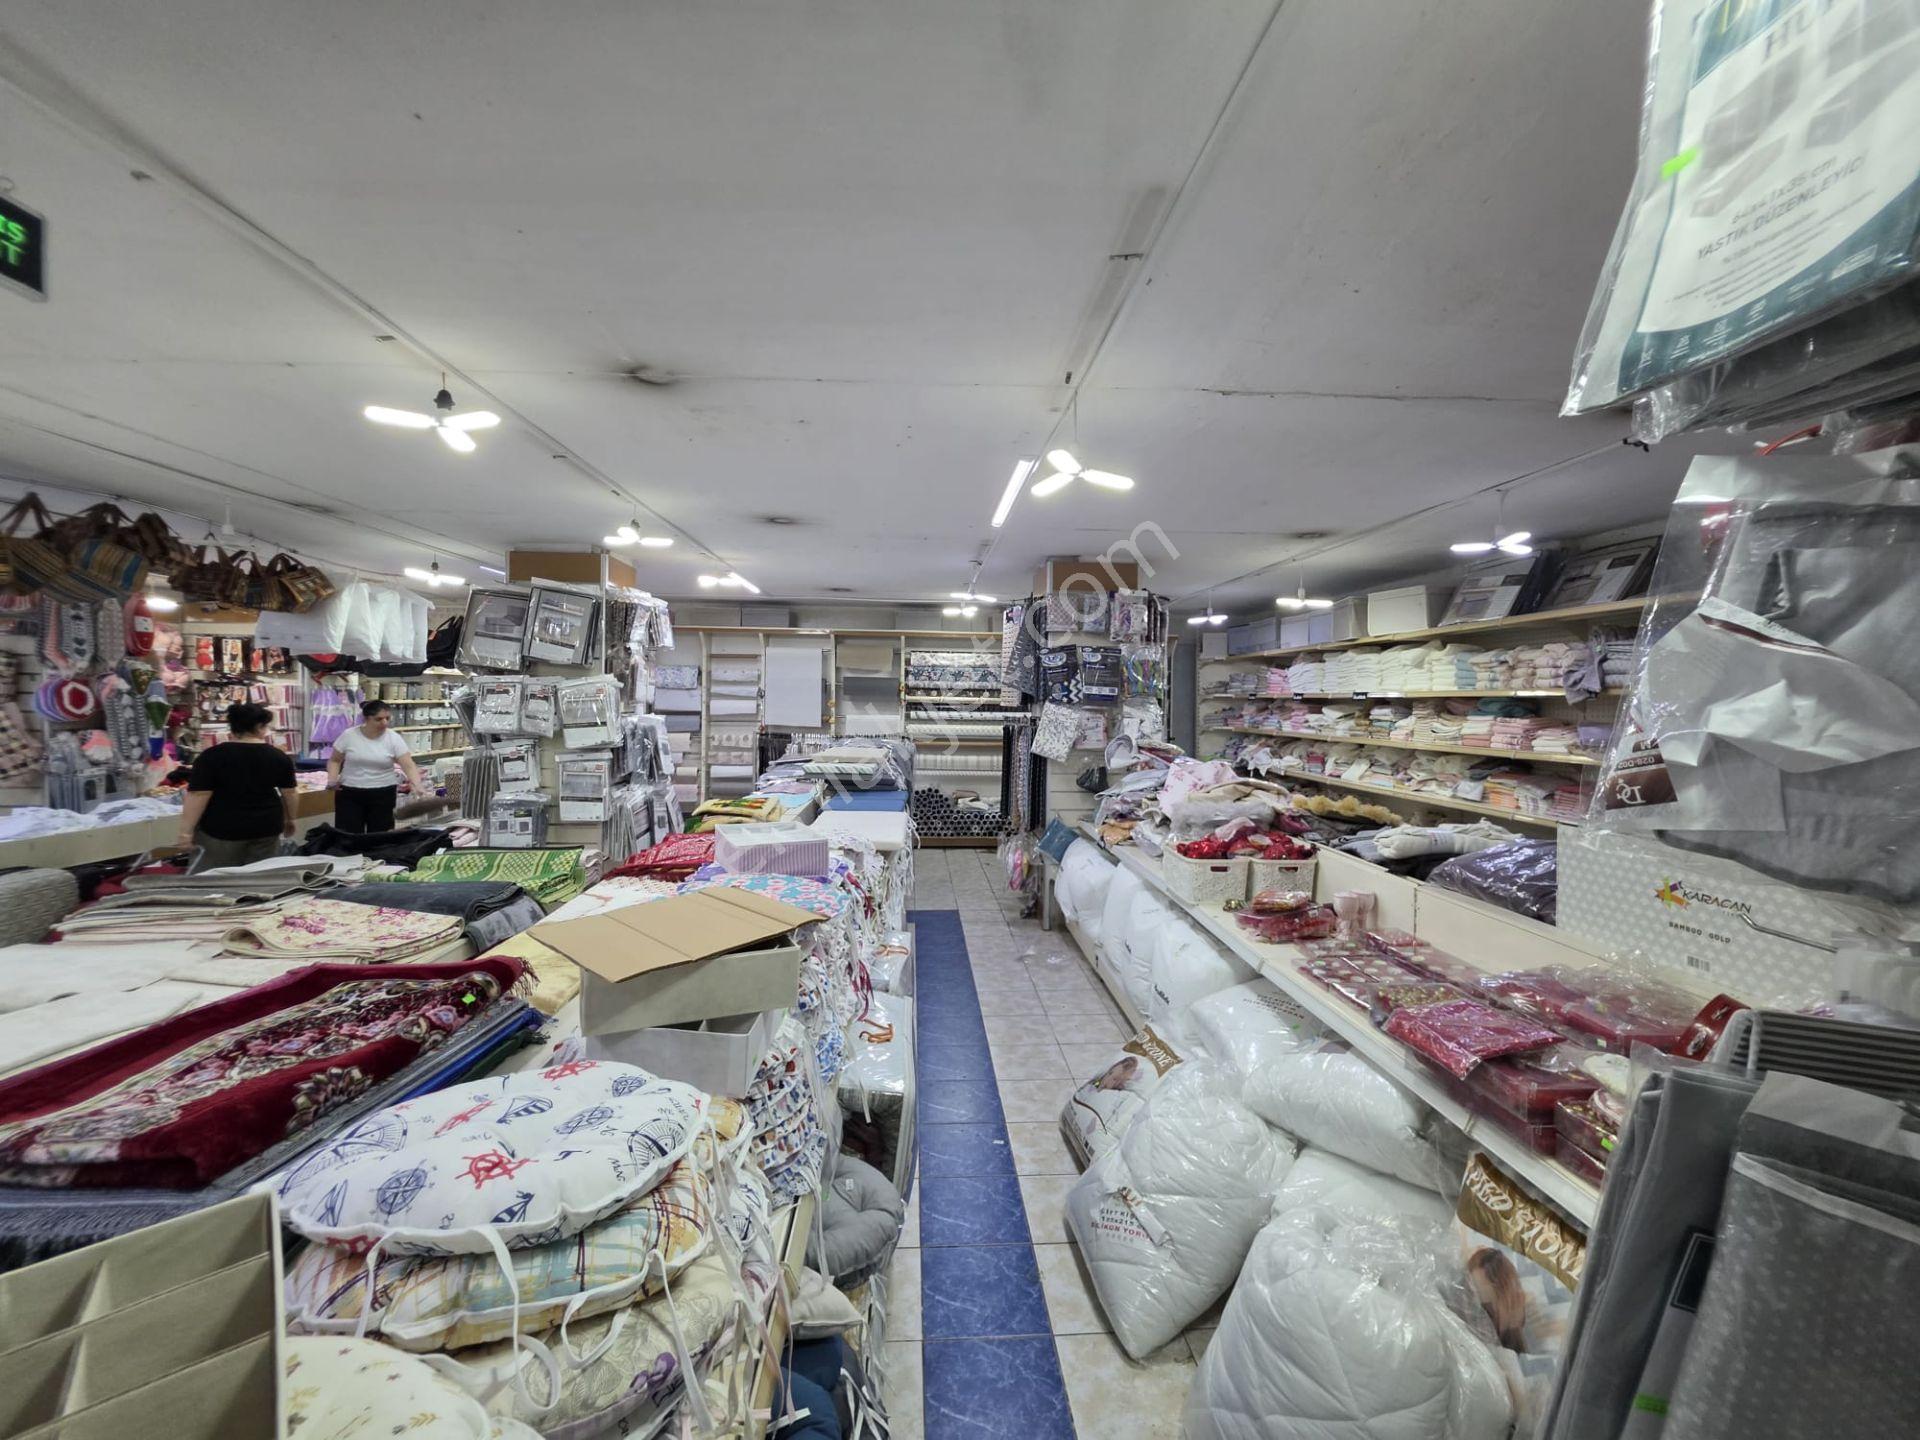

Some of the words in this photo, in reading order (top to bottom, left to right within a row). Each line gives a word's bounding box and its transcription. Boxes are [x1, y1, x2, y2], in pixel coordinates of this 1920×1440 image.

[1682, 889, 1752, 914] KARACAN
[1668, 920, 1703, 937] BAMBOO
[1708, 932, 1732, 945] GOLD
